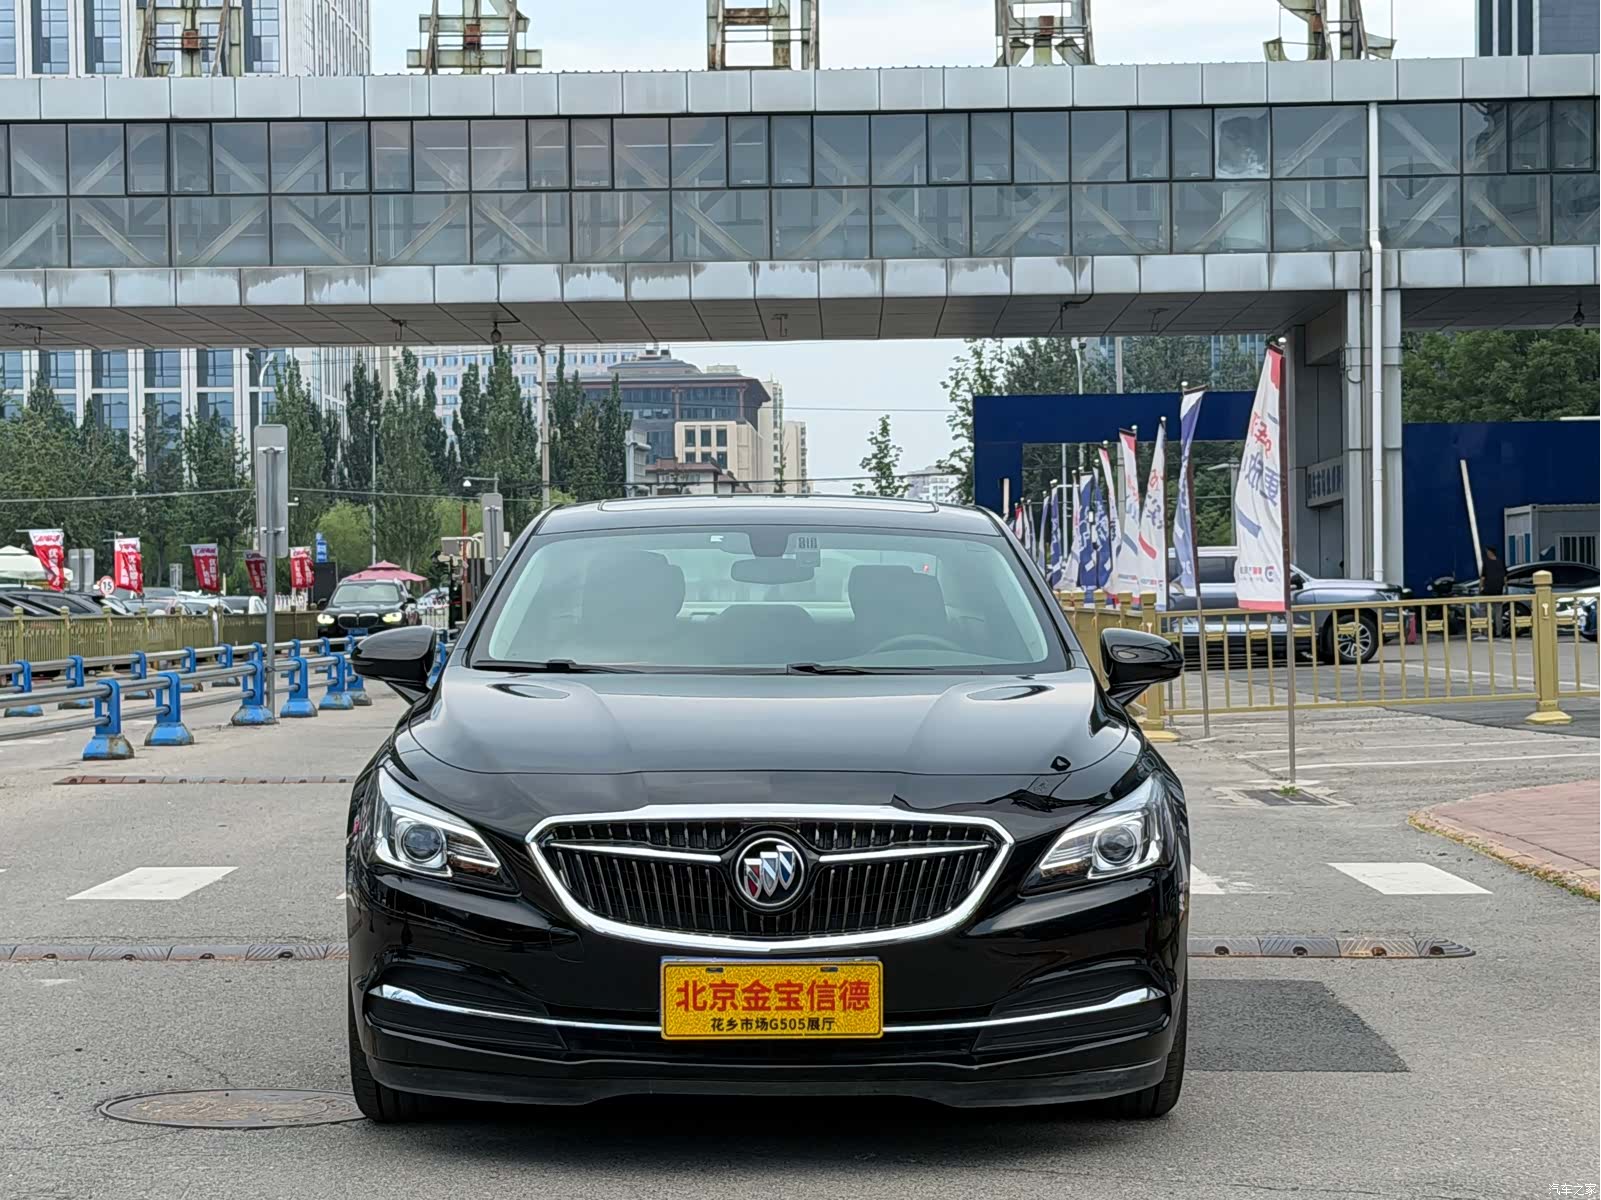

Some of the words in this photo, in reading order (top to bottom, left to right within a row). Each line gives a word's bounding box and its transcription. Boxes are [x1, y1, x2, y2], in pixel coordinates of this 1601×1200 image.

[103, 581, 113, 592] 15
[675, 979, 871, 1012] 北京金宝信德
[710, 1017, 836, 1031] 花乡市场G505展厅
